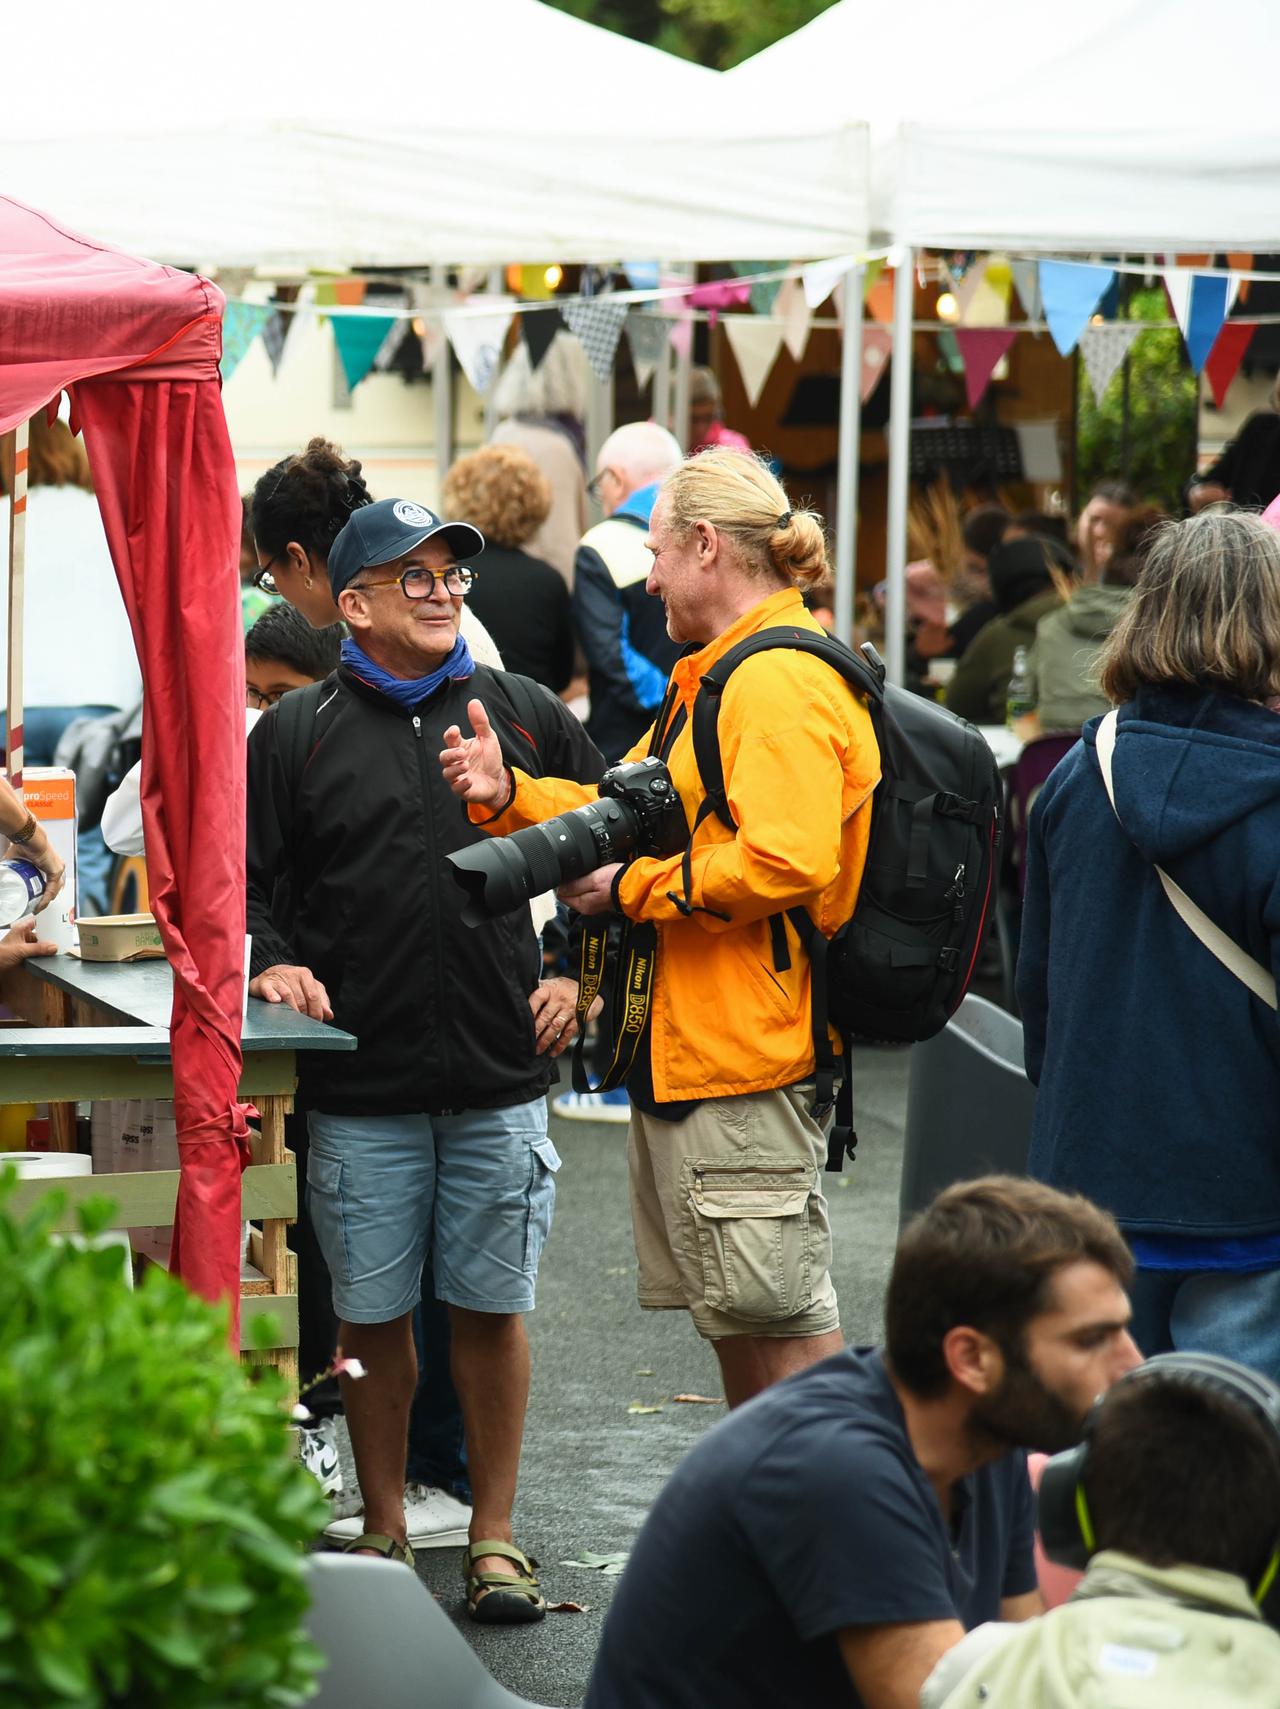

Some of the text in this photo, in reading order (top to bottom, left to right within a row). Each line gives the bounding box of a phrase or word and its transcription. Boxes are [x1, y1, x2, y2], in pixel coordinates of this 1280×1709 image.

[588, 936, 600, 970] Nikon
[625, 957, 648, 1034] Nikon D850
